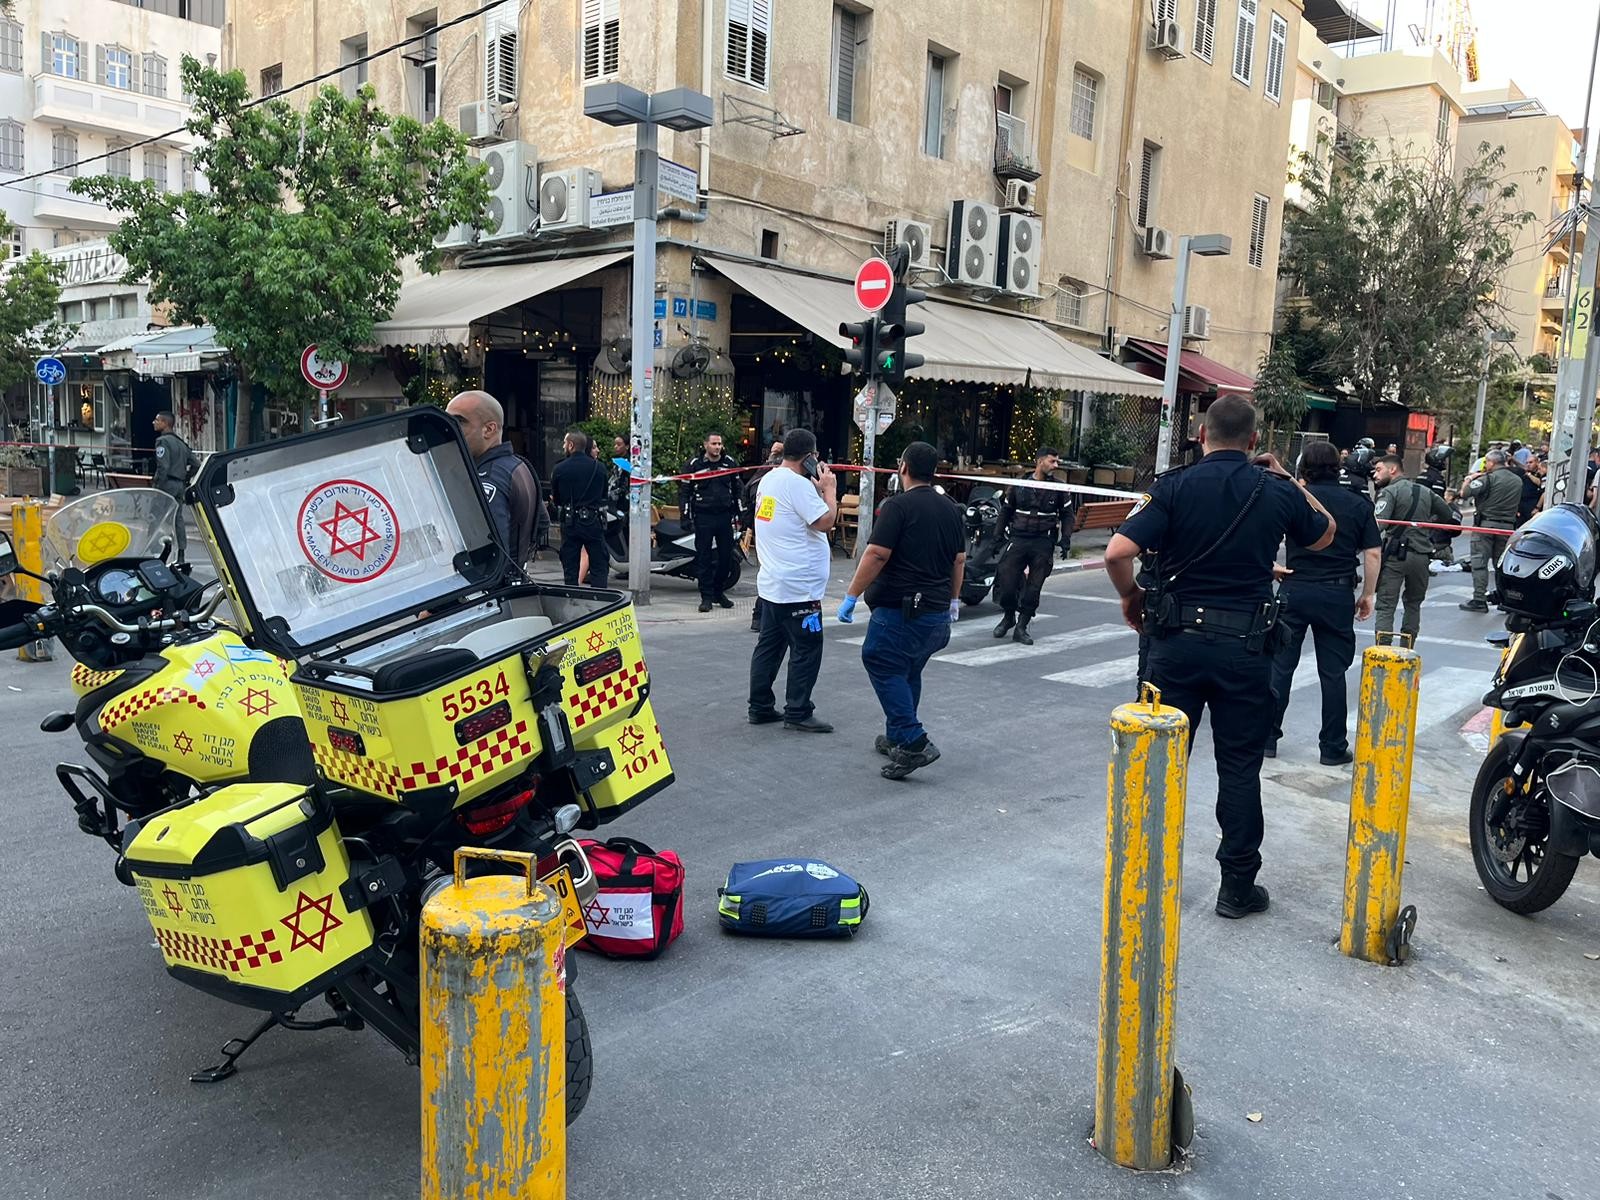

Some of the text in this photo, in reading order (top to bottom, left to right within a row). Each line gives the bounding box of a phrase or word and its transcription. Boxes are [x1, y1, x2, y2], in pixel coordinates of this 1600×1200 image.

[674, 302, 685, 313] 17
[304, 486, 382, 530] מגן דוד אדום בישראל
[306, 512, 394, 576] MAGEN DAVID ADOM IN ISRAEL
[1542, 558, 1563, 576] SHOEI
[442, 671, 510, 721] 5534
[1529, 684, 1555, 693] משטרת
[131, 721, 160, 731] MAGEN
[203, 733, 235, 747] מגן דוד
[210, 746, 234, 757] אדום
[199, 752, 232, 768] בישראל
[622, 749, 658, 780] 101
